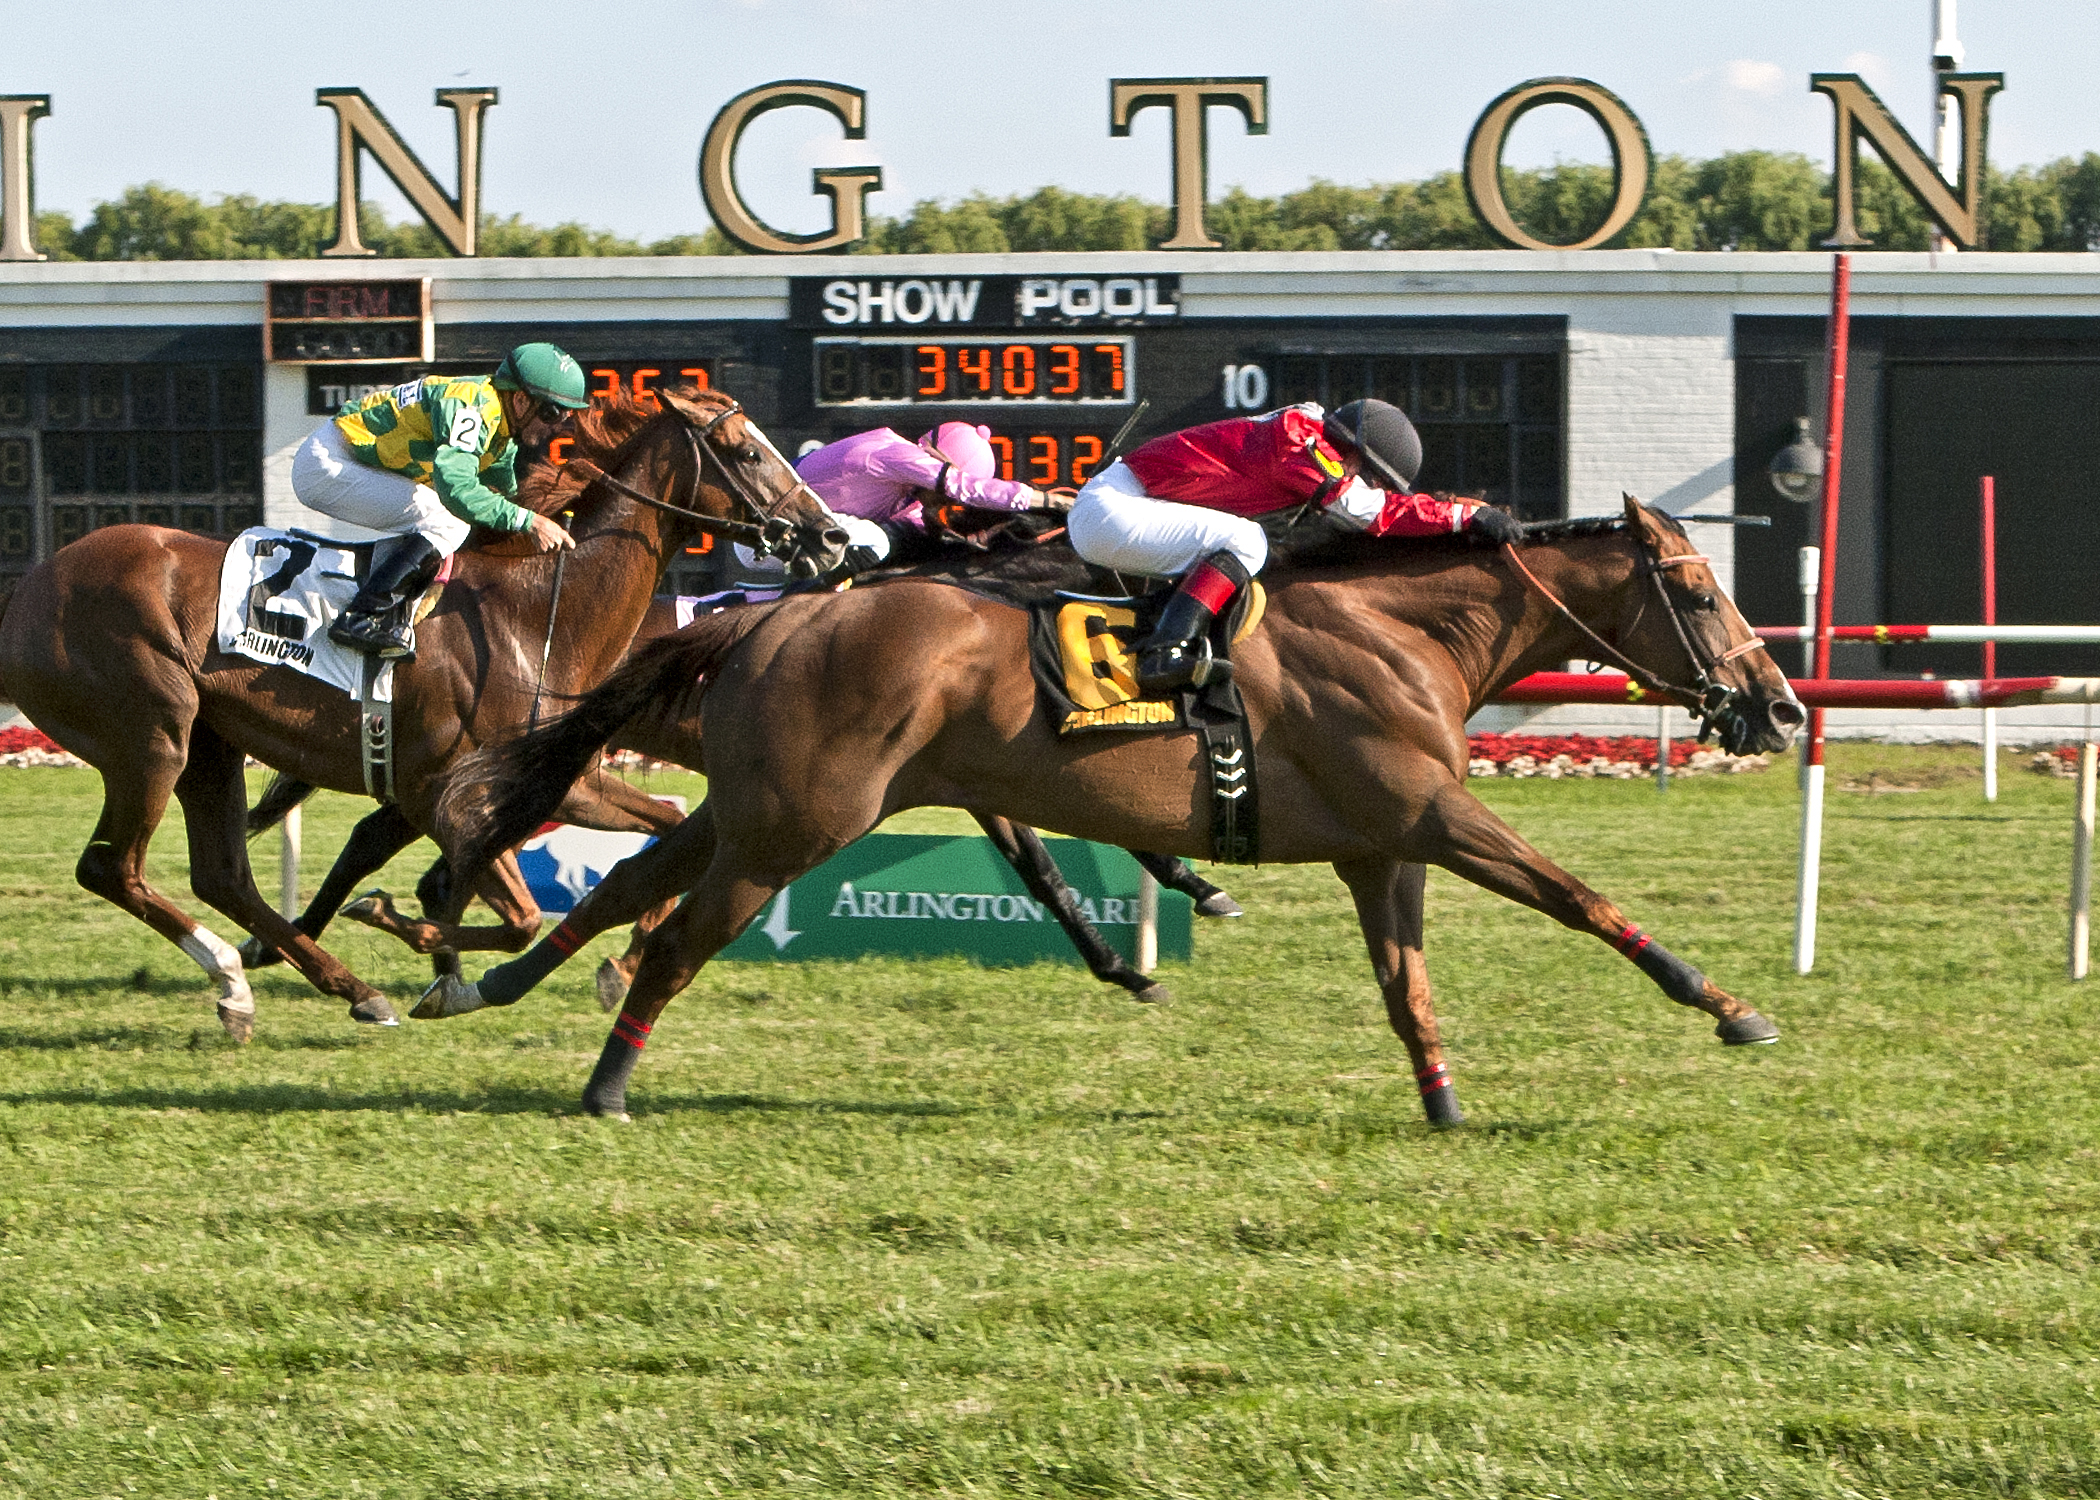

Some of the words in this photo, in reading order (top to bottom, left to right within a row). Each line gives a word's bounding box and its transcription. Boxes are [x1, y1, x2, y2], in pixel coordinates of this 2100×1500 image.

[822, 280, 983, 325] SHOW
[1020, 278, 1178, 317] POOL
[917, 345, 1124, 395] 34037
[1222, 363, 1269, 409] 10
[457, 417, 477, 446] 2
[246, 537, 318, 641] 2
[829, 881, 1044, 922] ARLINGTON
